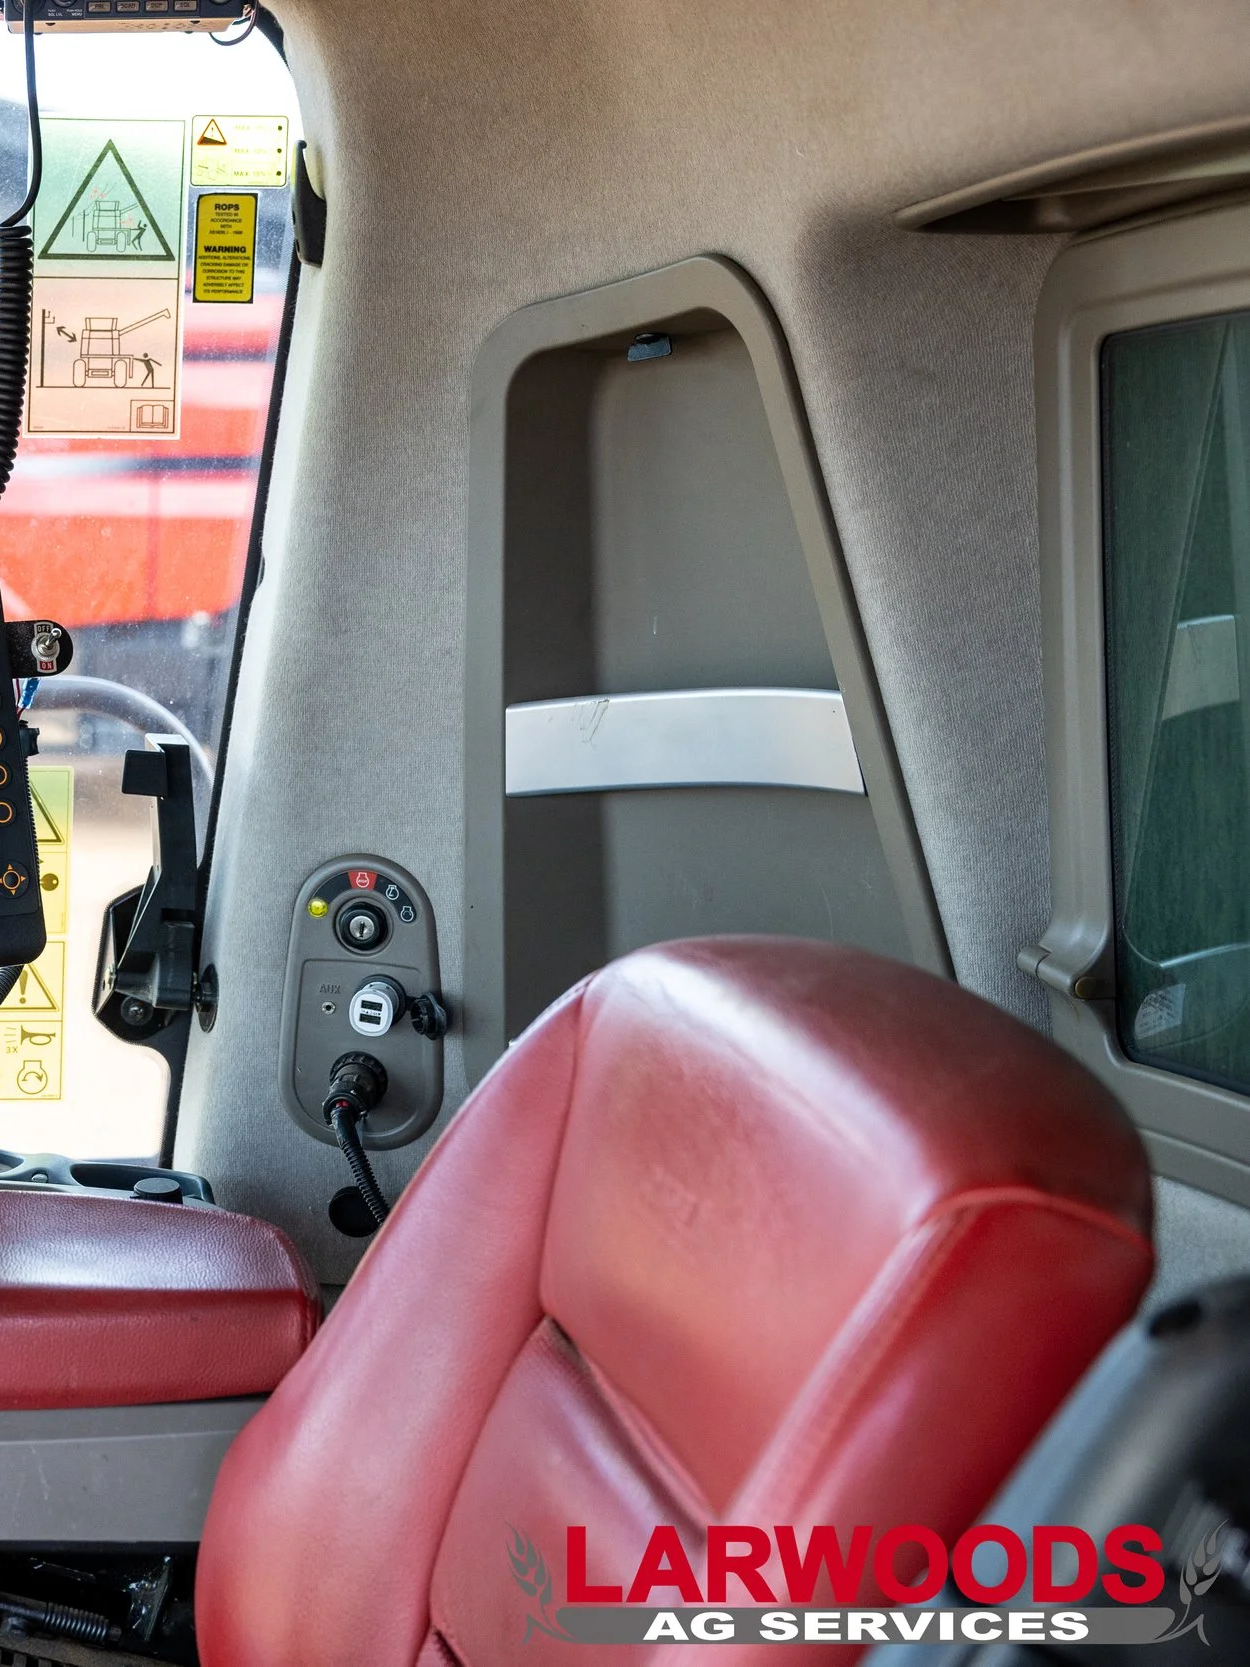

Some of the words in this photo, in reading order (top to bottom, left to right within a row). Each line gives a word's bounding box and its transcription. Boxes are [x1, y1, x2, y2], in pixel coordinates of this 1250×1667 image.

[214, 203, 240, 211] ROPS
[204, 245, 247, 254] WARNING
[319, 984, 341, 994] AUX
